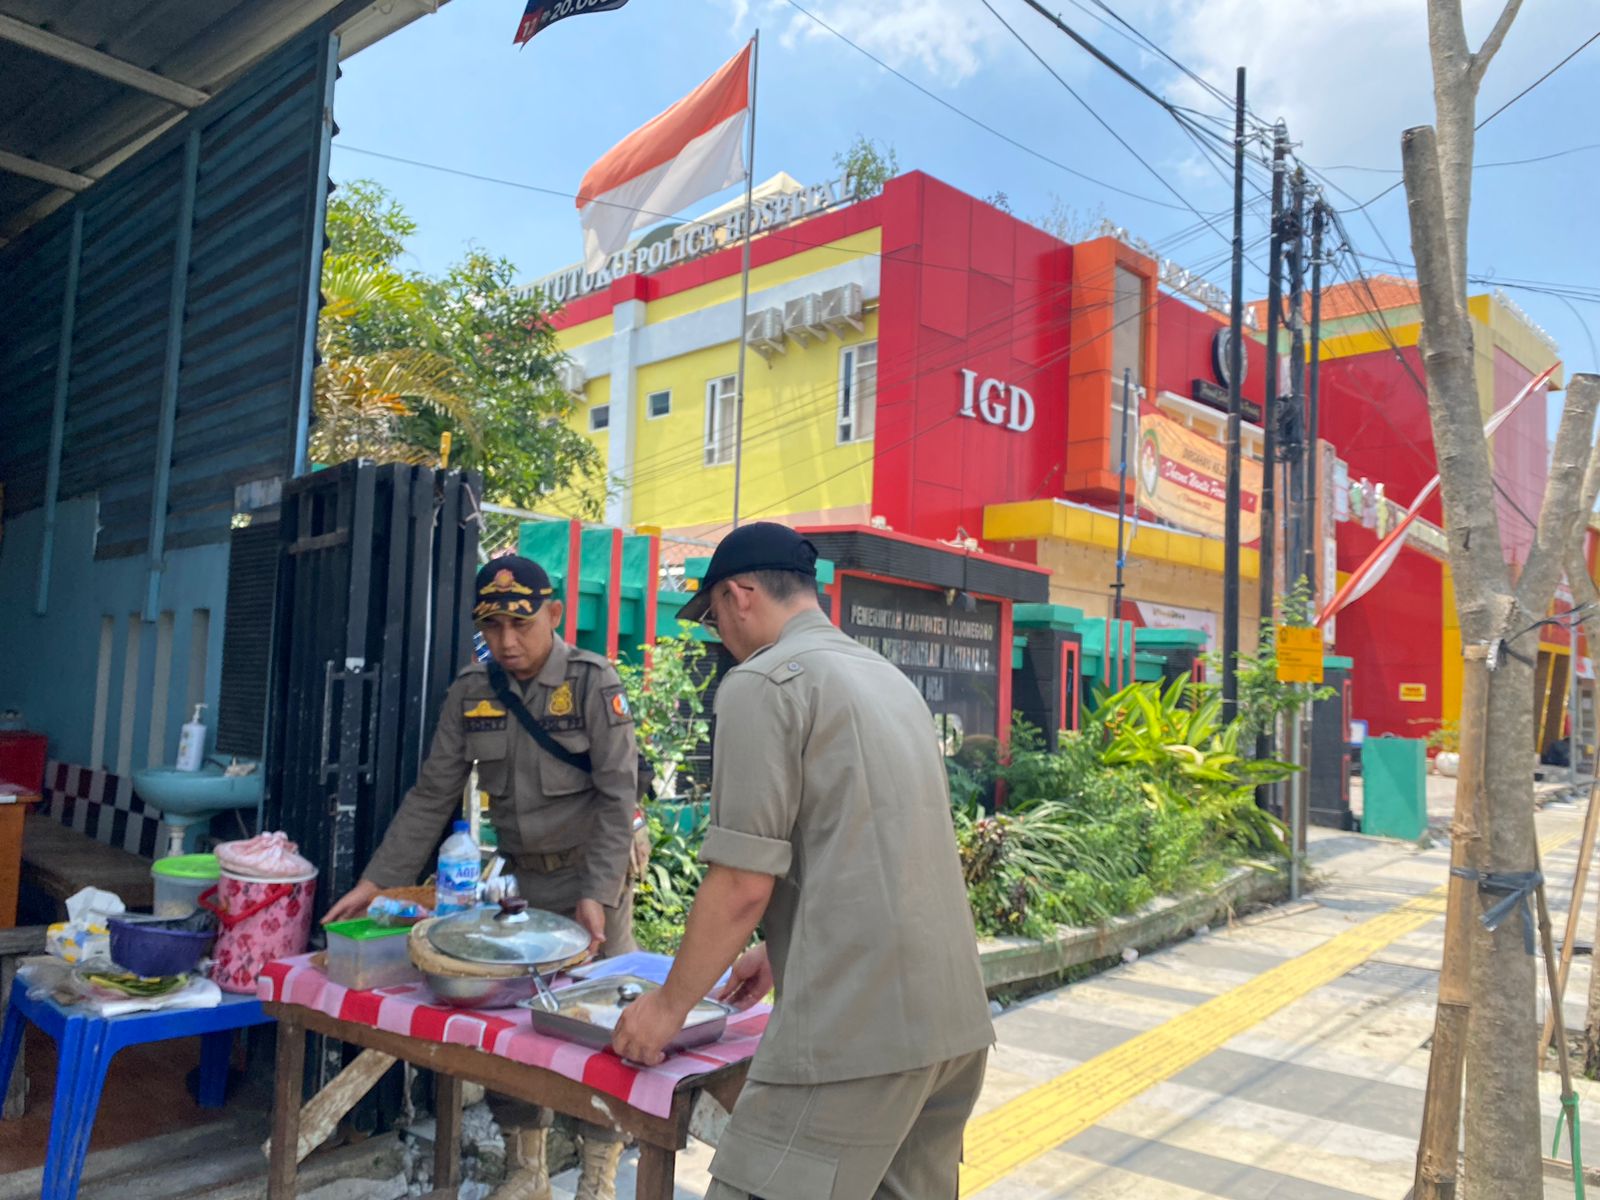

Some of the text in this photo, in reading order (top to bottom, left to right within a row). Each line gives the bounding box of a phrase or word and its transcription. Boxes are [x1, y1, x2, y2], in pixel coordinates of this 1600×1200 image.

[636, 222, 717, 274] POLICE
[724, 171, 858, 242] HOSPITAL
[960, 367, 1035, 432] IGD
